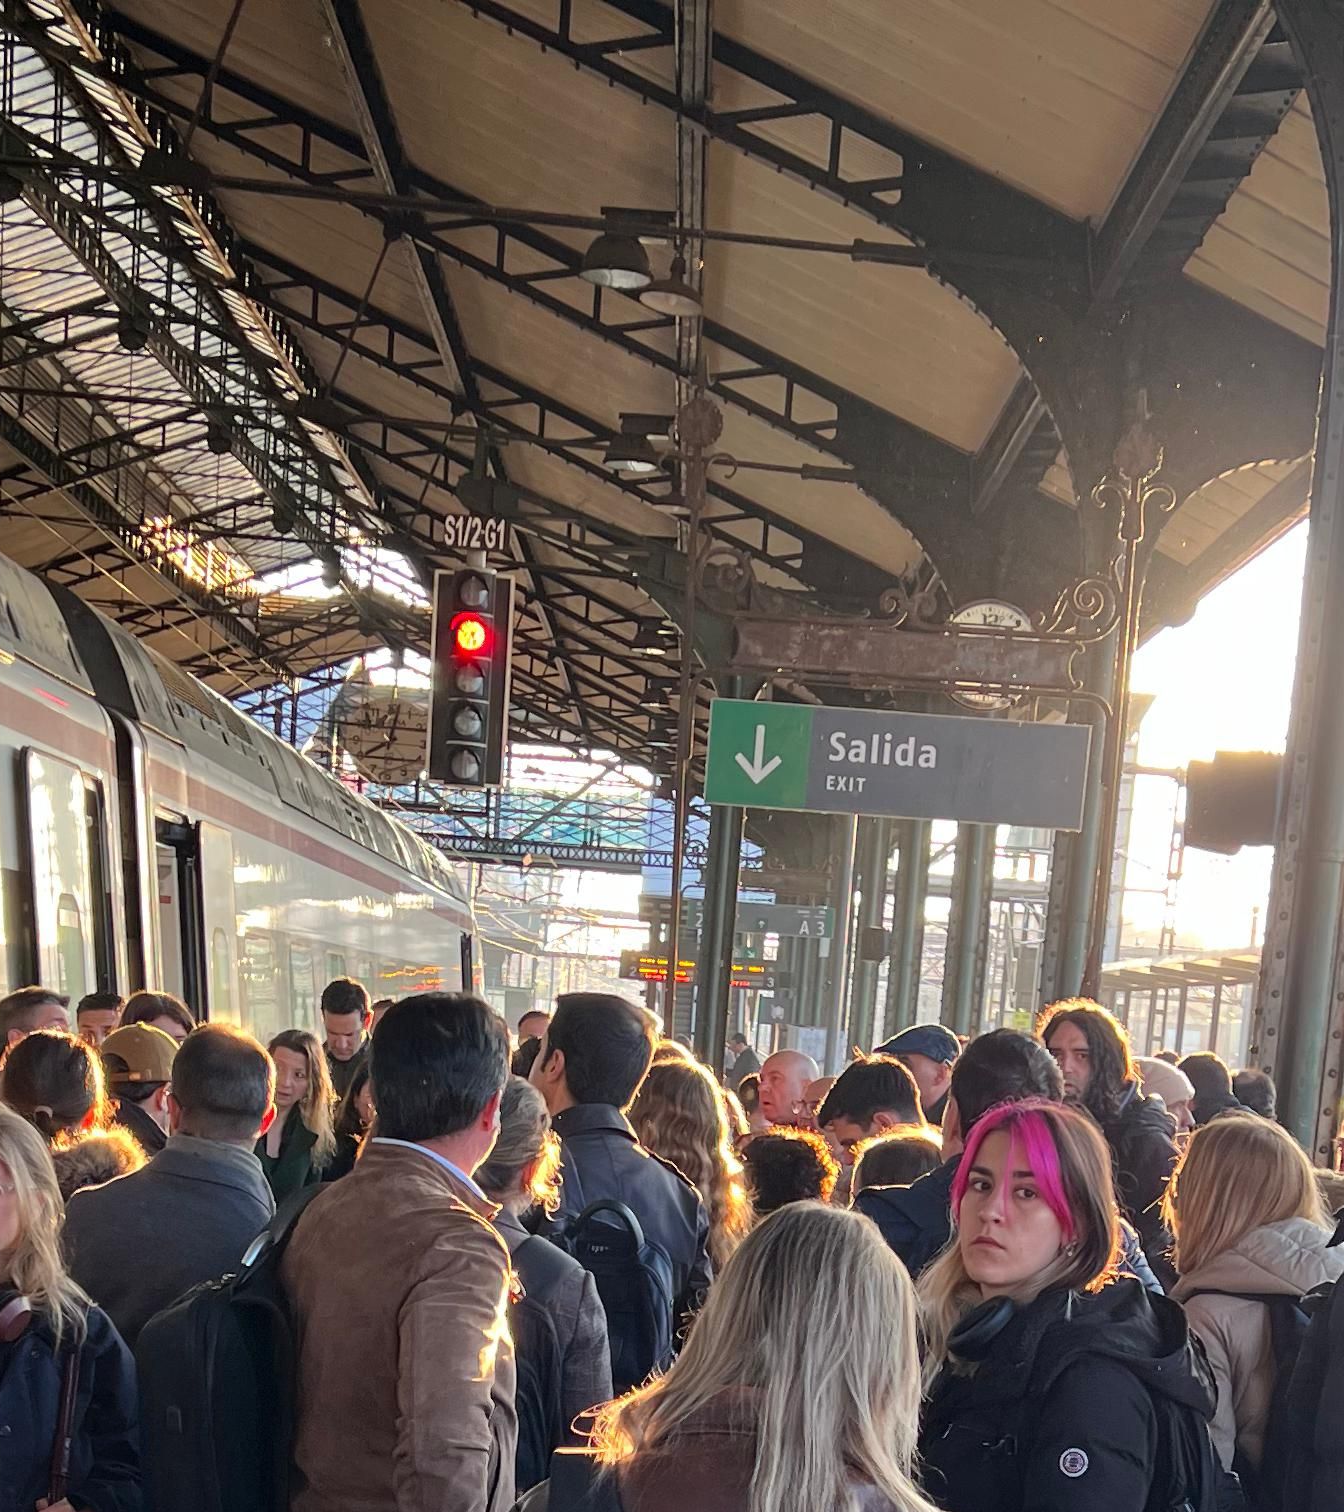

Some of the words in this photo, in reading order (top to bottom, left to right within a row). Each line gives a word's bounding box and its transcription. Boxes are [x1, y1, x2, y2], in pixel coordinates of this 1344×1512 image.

[828, 731, 937, 769] Salida
[825, 775, 867, 793] EXIT
[799, 920, 810, 936] A
[816, 921, 825, 936] 3
[767, 976, 775, 988] 3
